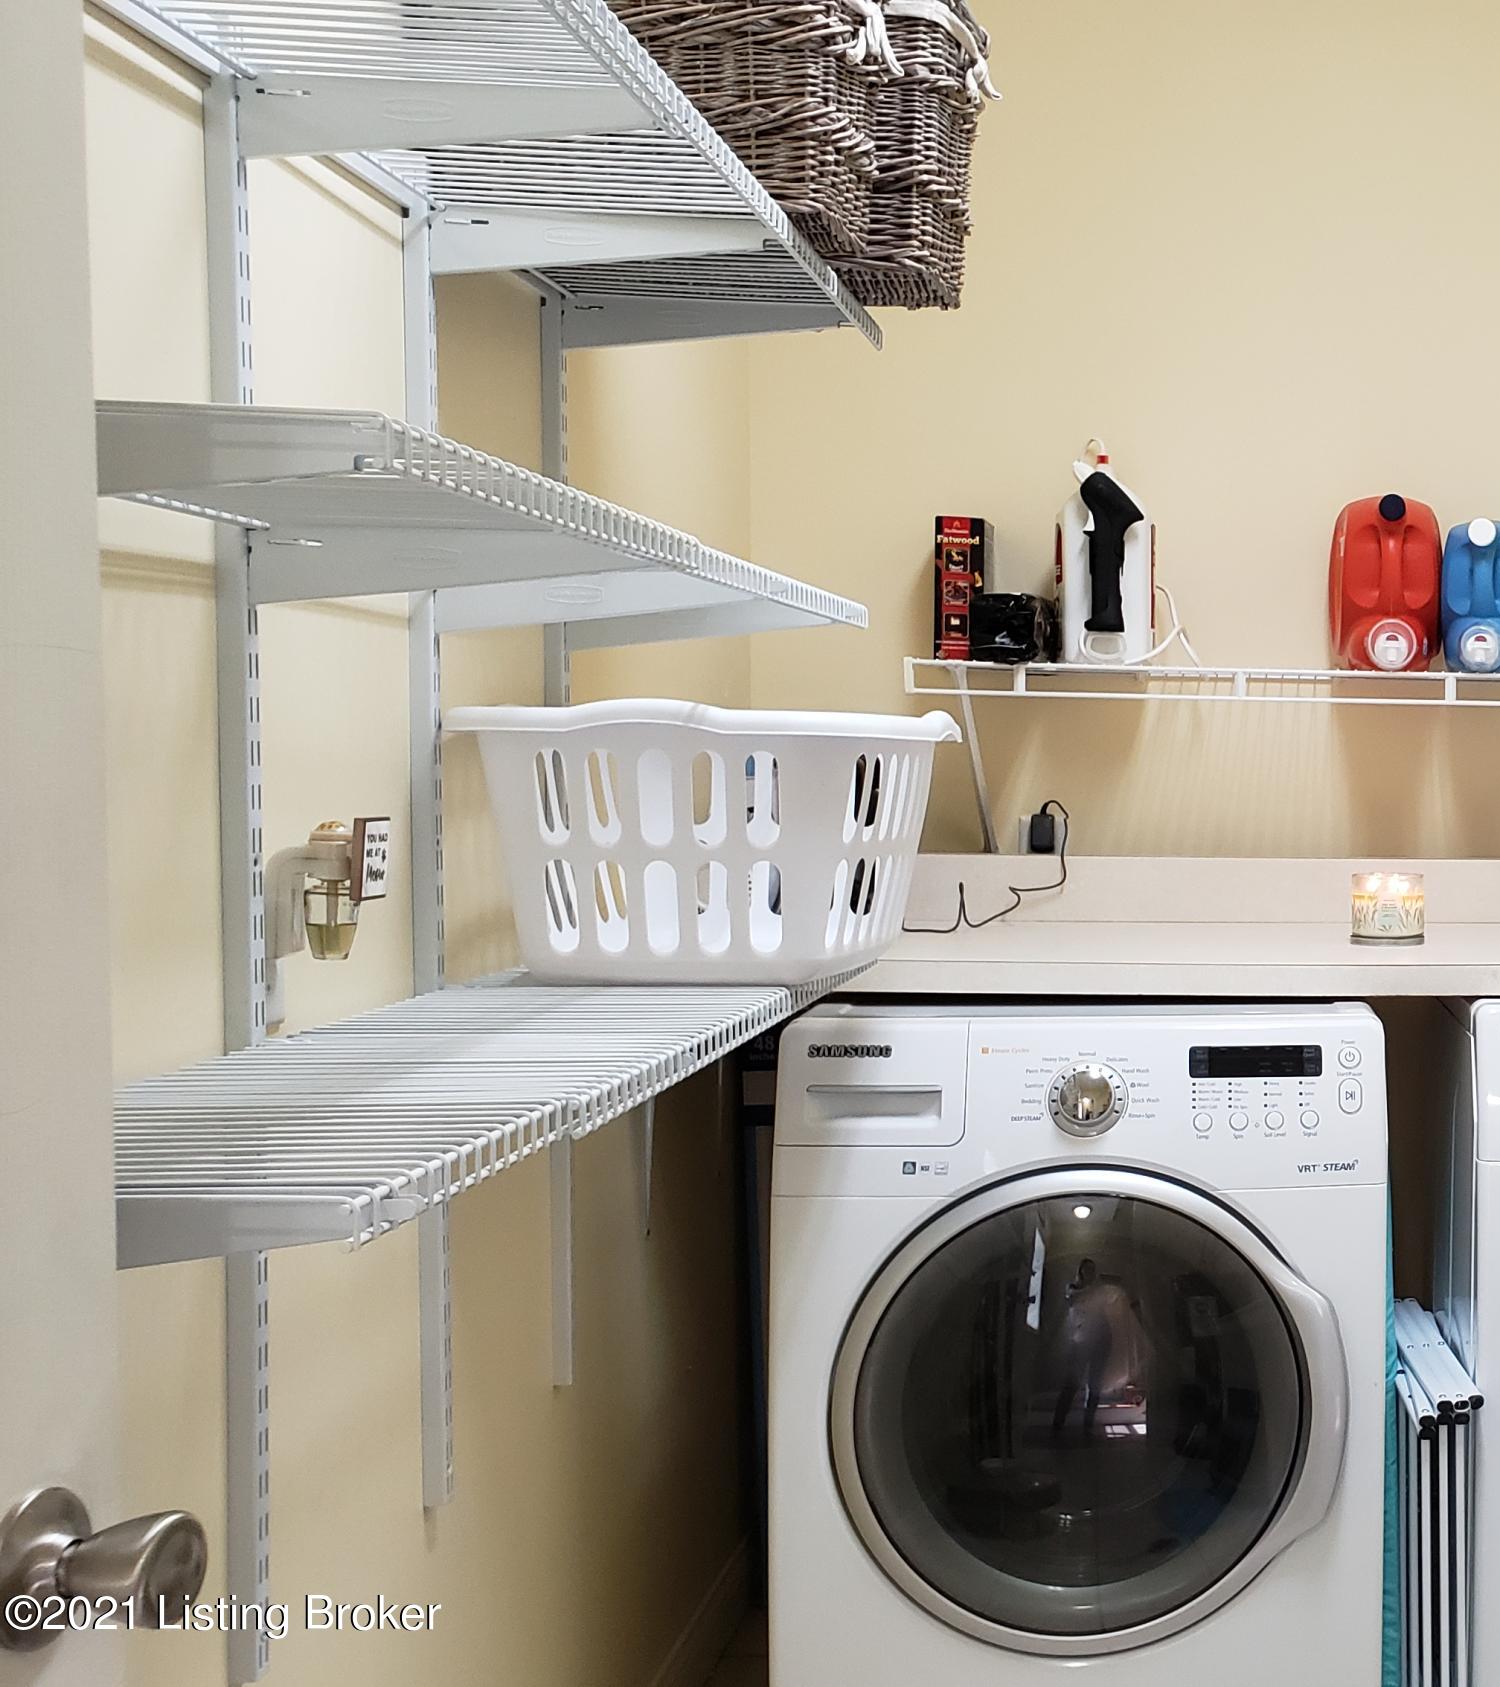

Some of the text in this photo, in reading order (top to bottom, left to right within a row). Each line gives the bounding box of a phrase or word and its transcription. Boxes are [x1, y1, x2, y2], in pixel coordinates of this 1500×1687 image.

[936, 535, 980, 545] Fatwood
[808, 1044, 892, 1058] SAMSUNG
[1323, 1162, 1356, 1172] STEAM
